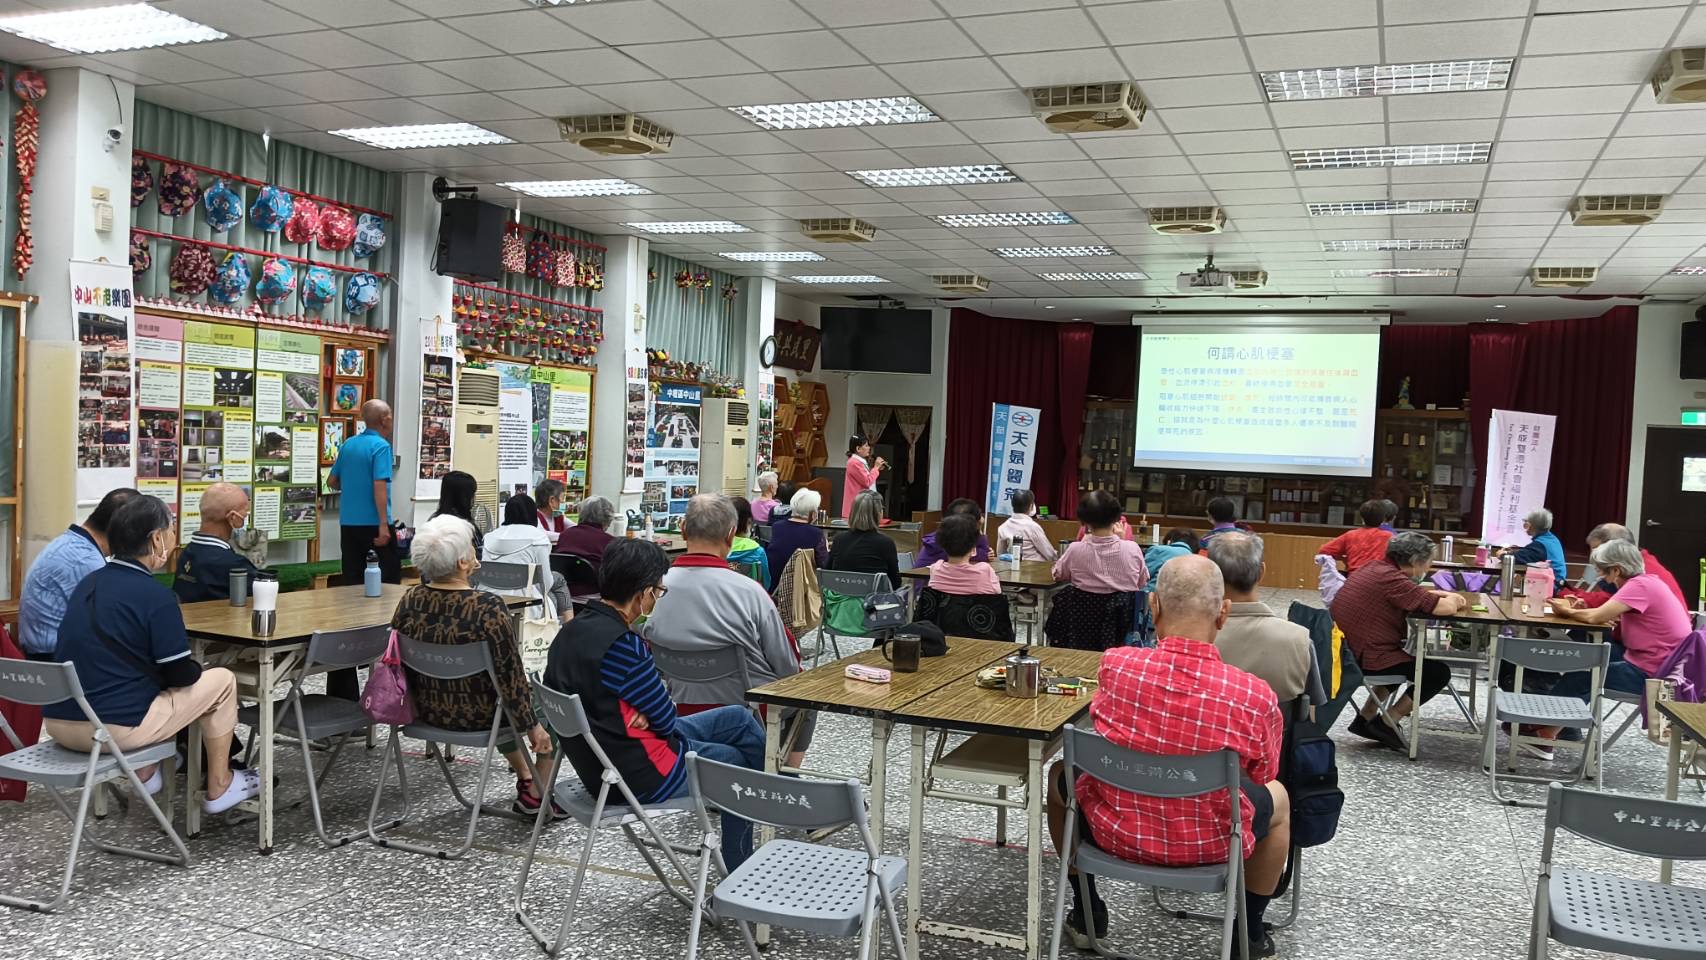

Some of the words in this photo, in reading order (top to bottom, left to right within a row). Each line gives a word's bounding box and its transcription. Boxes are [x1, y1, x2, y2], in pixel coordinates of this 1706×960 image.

[1207, 346, 1295, 361] 何謂心肌梗塞
[1100, 755, 1198, 782] 中山里辦公處
[730, 782, 812, 809] 中山里辦公處
